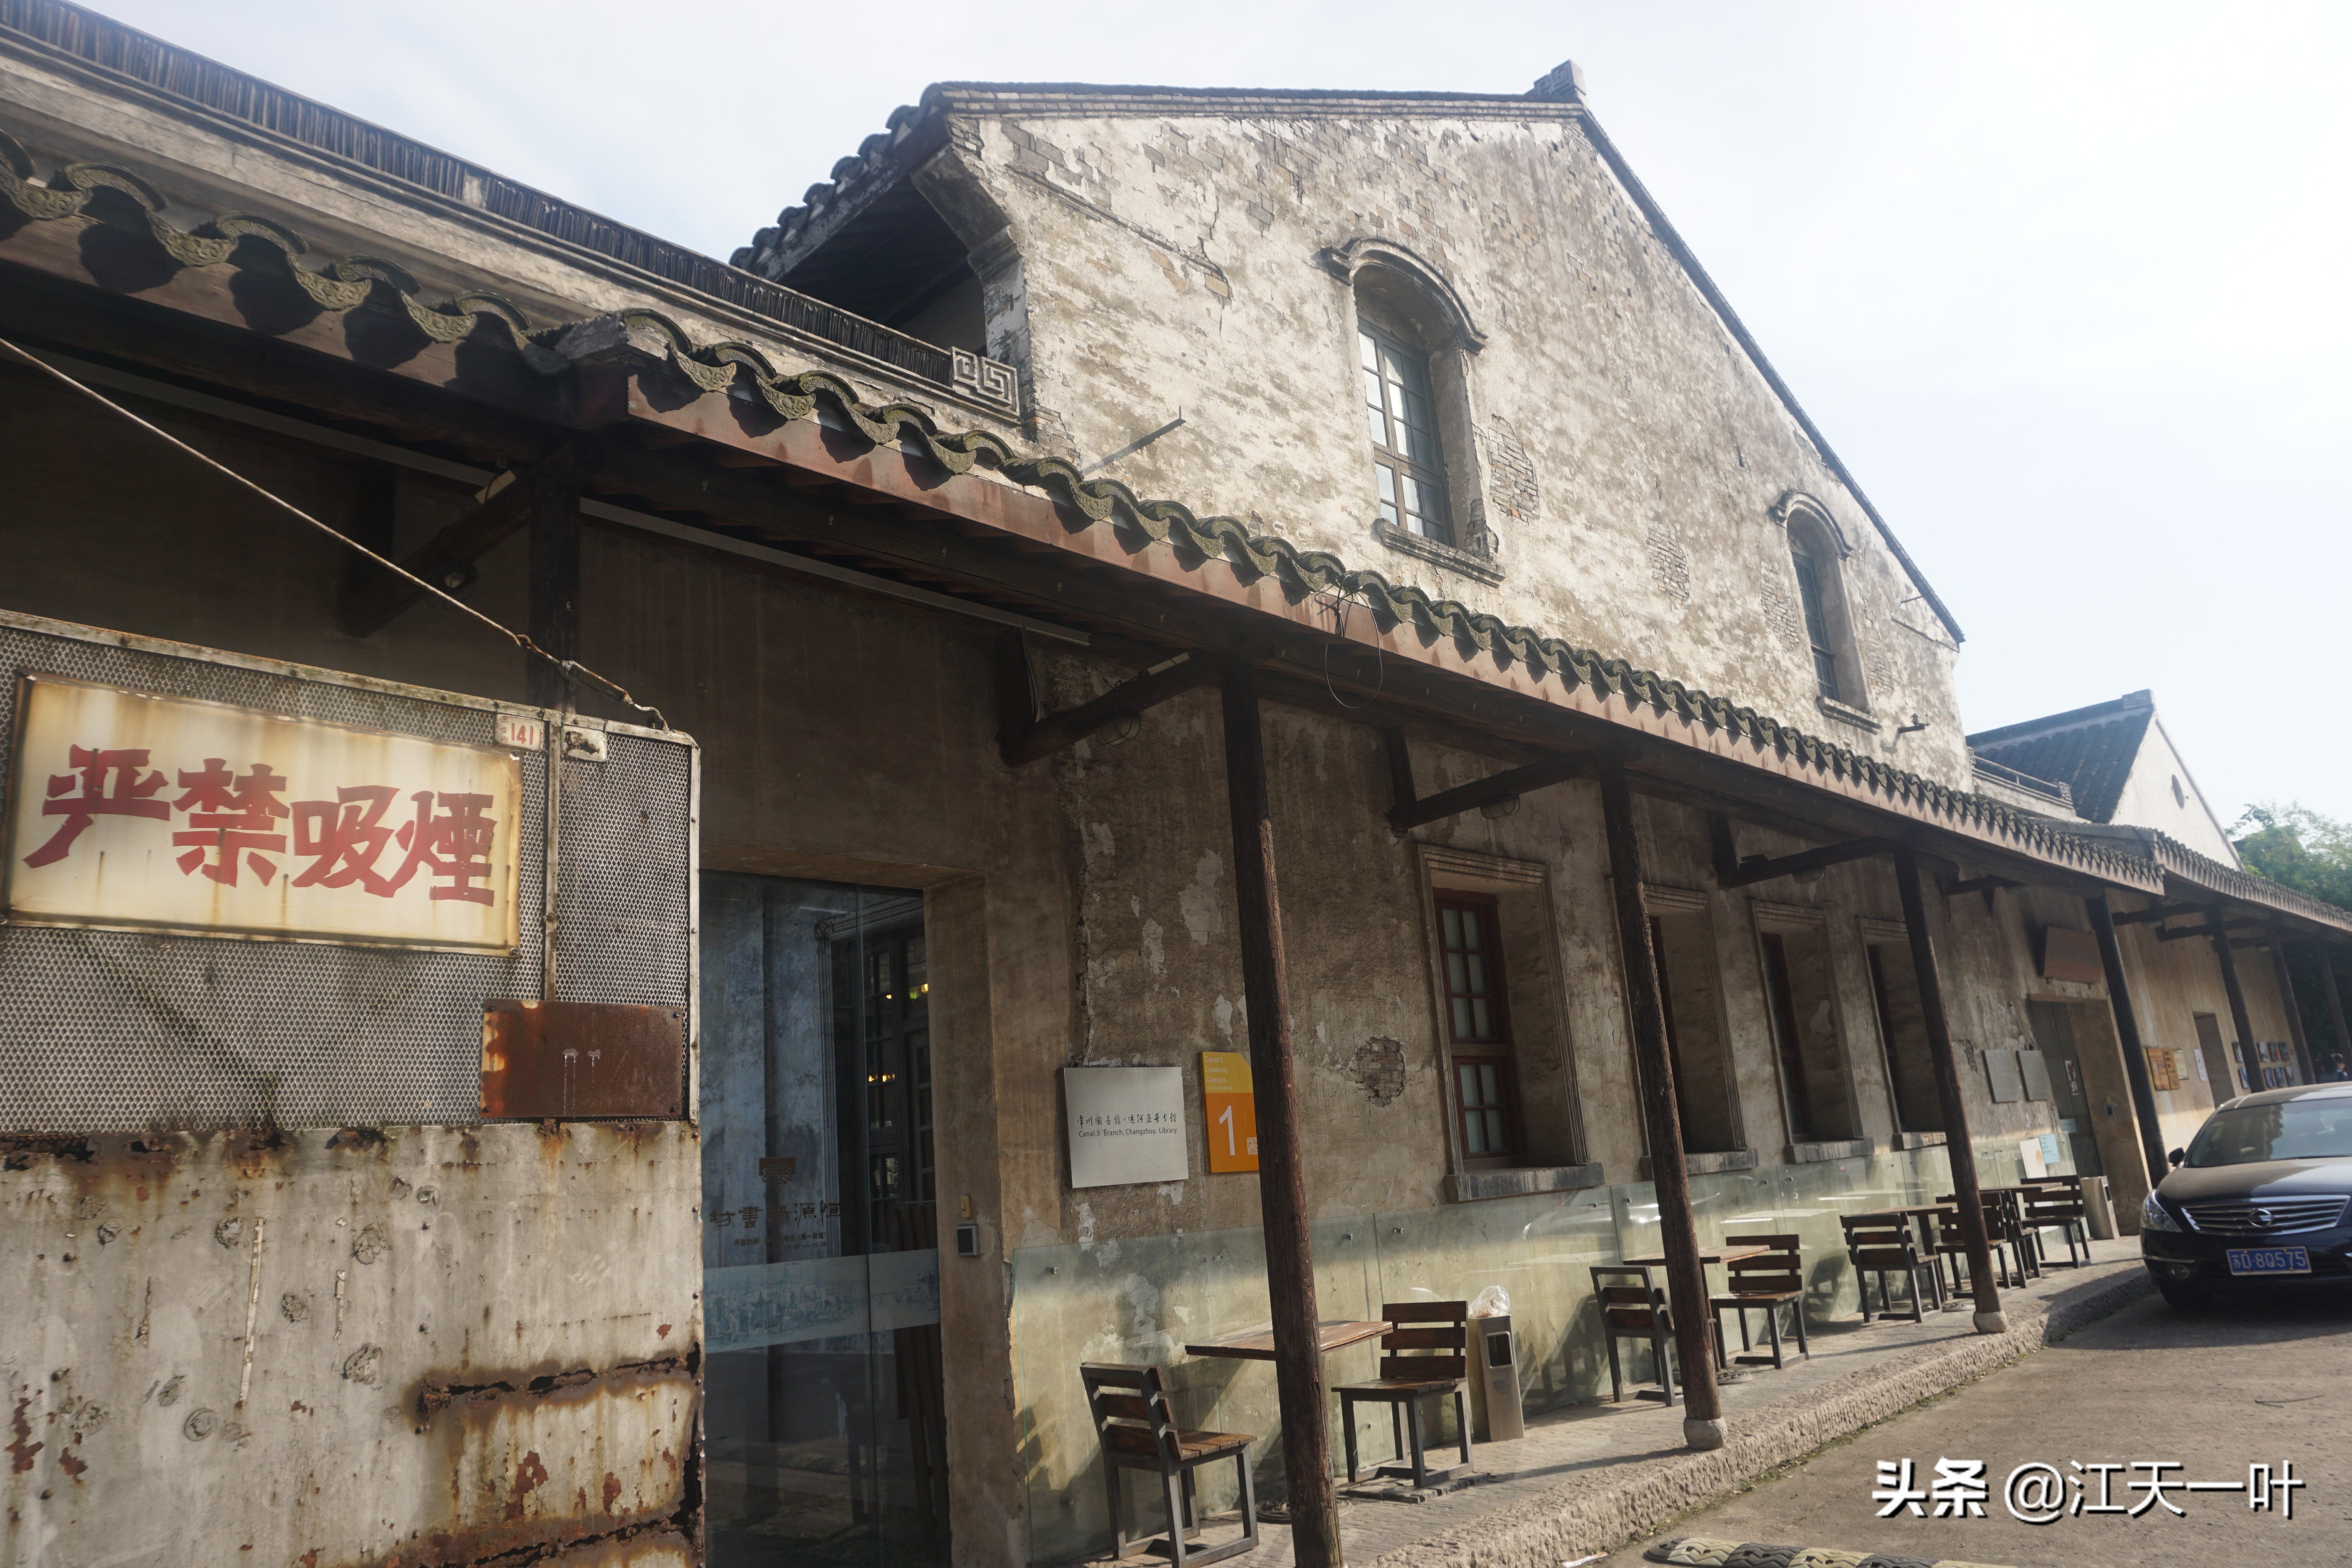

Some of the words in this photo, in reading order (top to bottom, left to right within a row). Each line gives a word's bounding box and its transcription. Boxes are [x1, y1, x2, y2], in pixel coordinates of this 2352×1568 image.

[511, 722, 533, 745] 141
[23, 744, 495, 907] 严禁吸煙
[1219, 1105, 1236, 1156] 1
